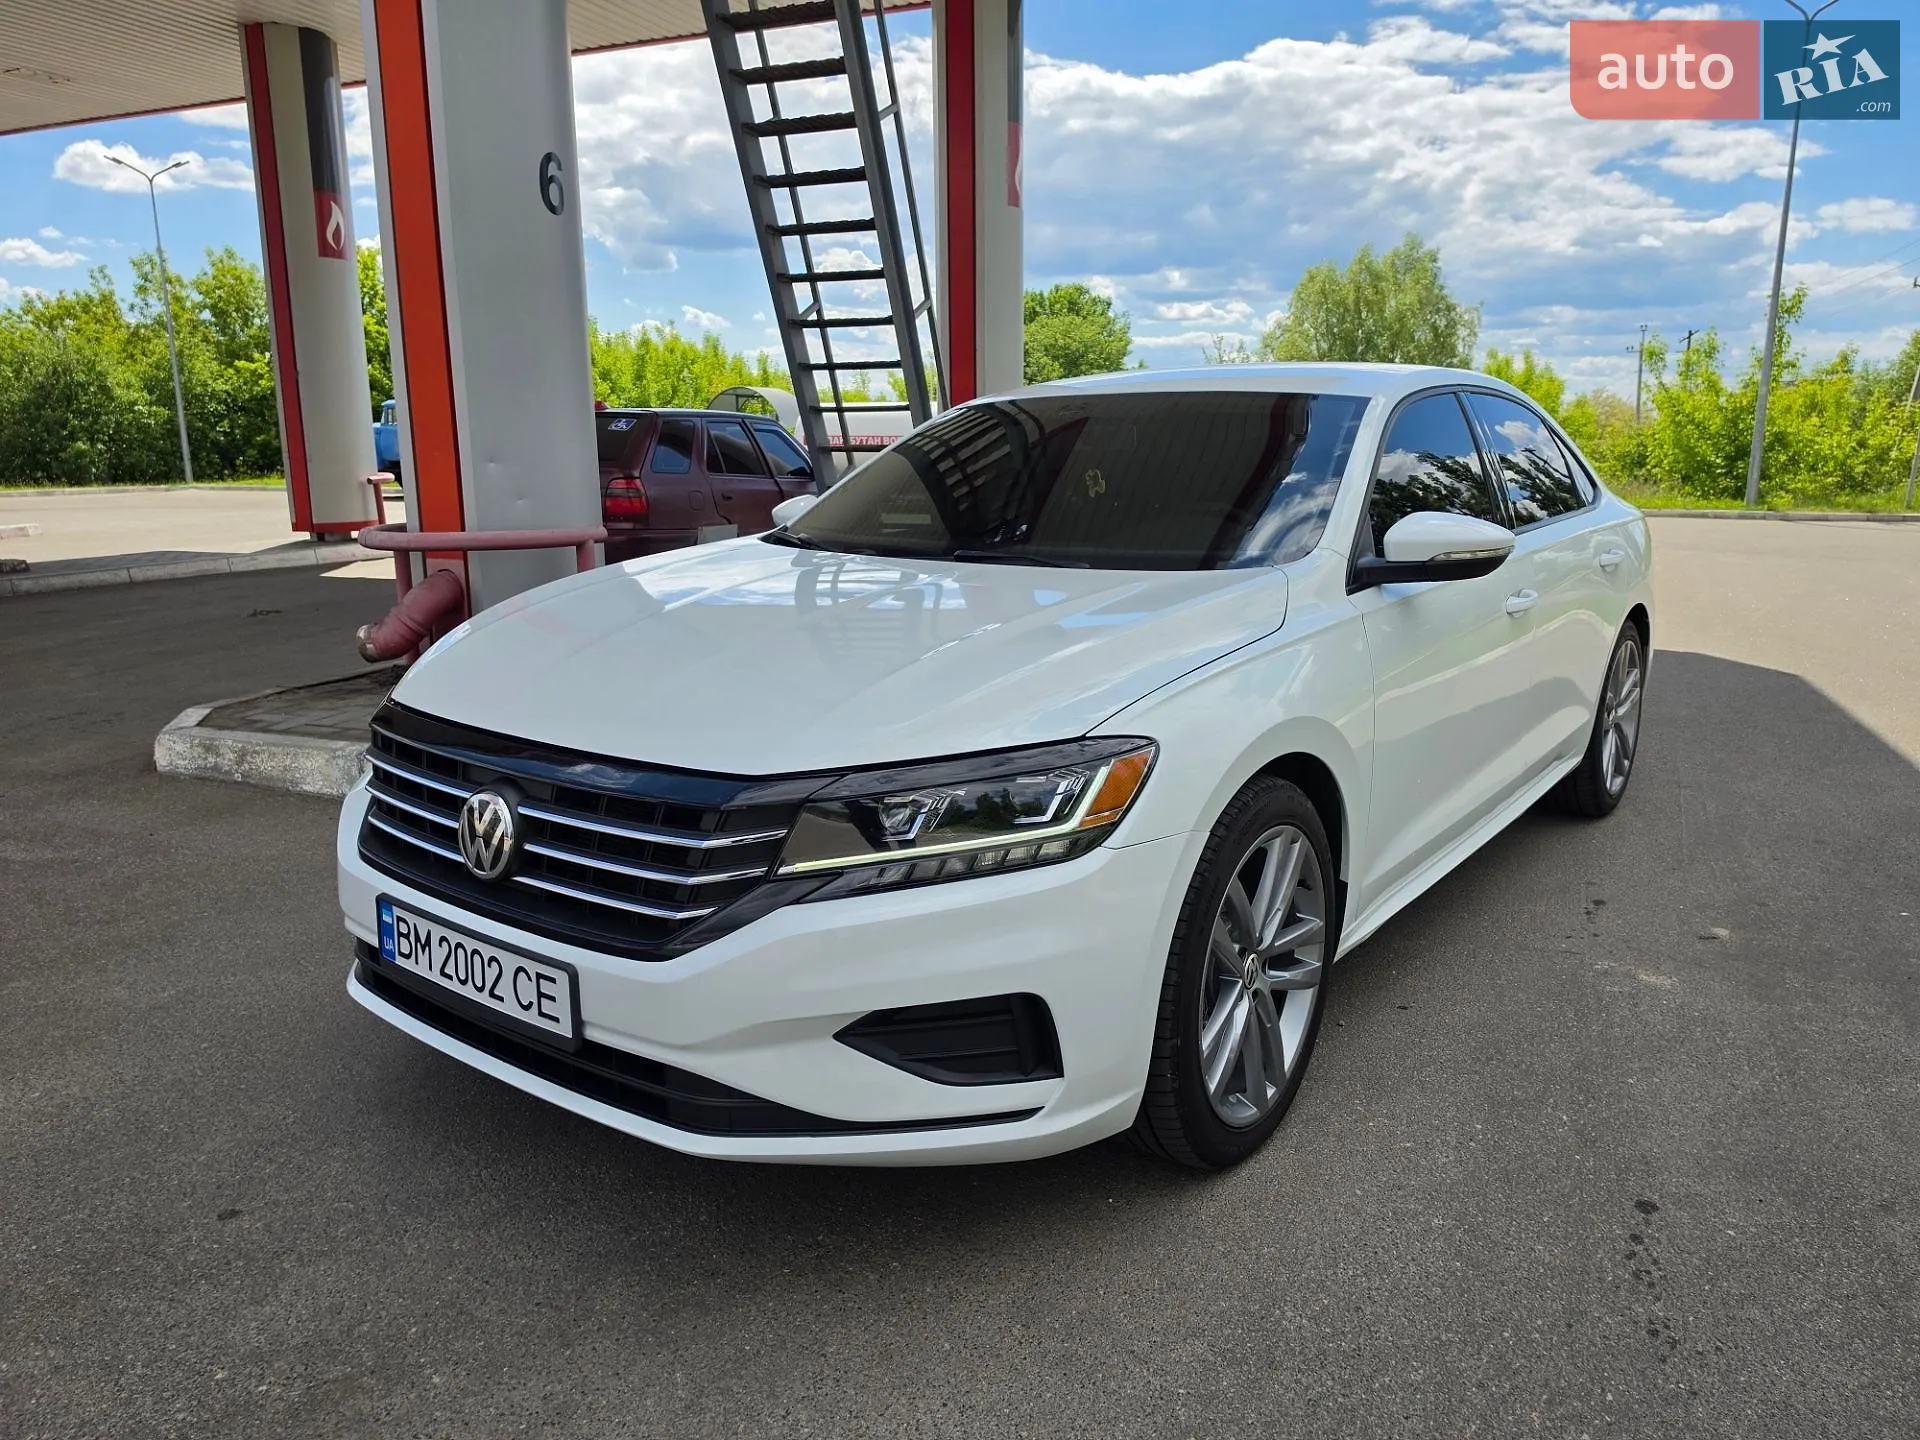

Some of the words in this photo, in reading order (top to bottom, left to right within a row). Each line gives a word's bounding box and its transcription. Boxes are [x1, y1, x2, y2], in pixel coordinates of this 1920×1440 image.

[539, 151, 564, 216] 6
[383, 935, 395, 953] UA
[396, 914, 433, 972] BM
[438, 935, 505, 1003] 2002
[513, 965, 560, 1024] CE
